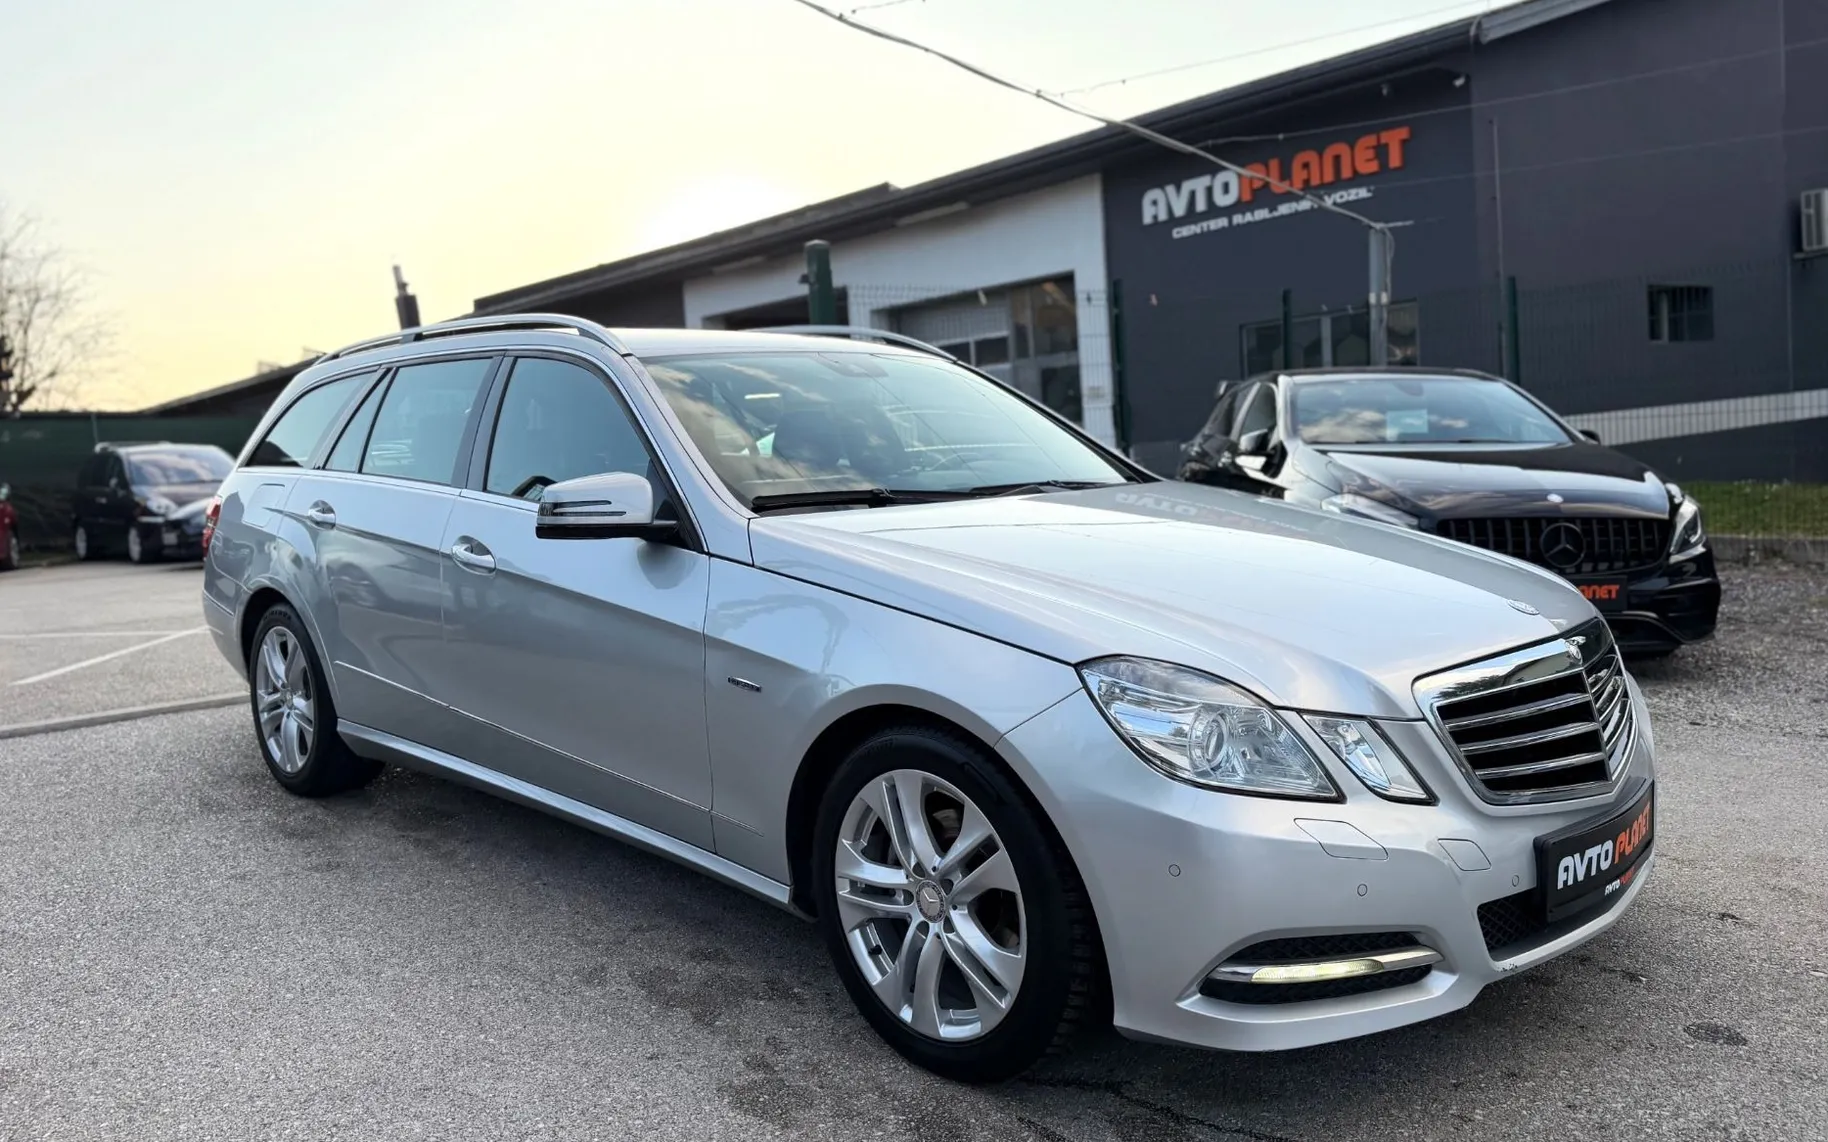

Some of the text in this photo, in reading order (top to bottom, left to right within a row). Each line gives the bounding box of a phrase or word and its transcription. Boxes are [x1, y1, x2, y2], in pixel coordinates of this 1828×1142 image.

[1172, 216, 1229, 239] CENTER
[1557, 801, 1650, 890] AVTO PLANET
